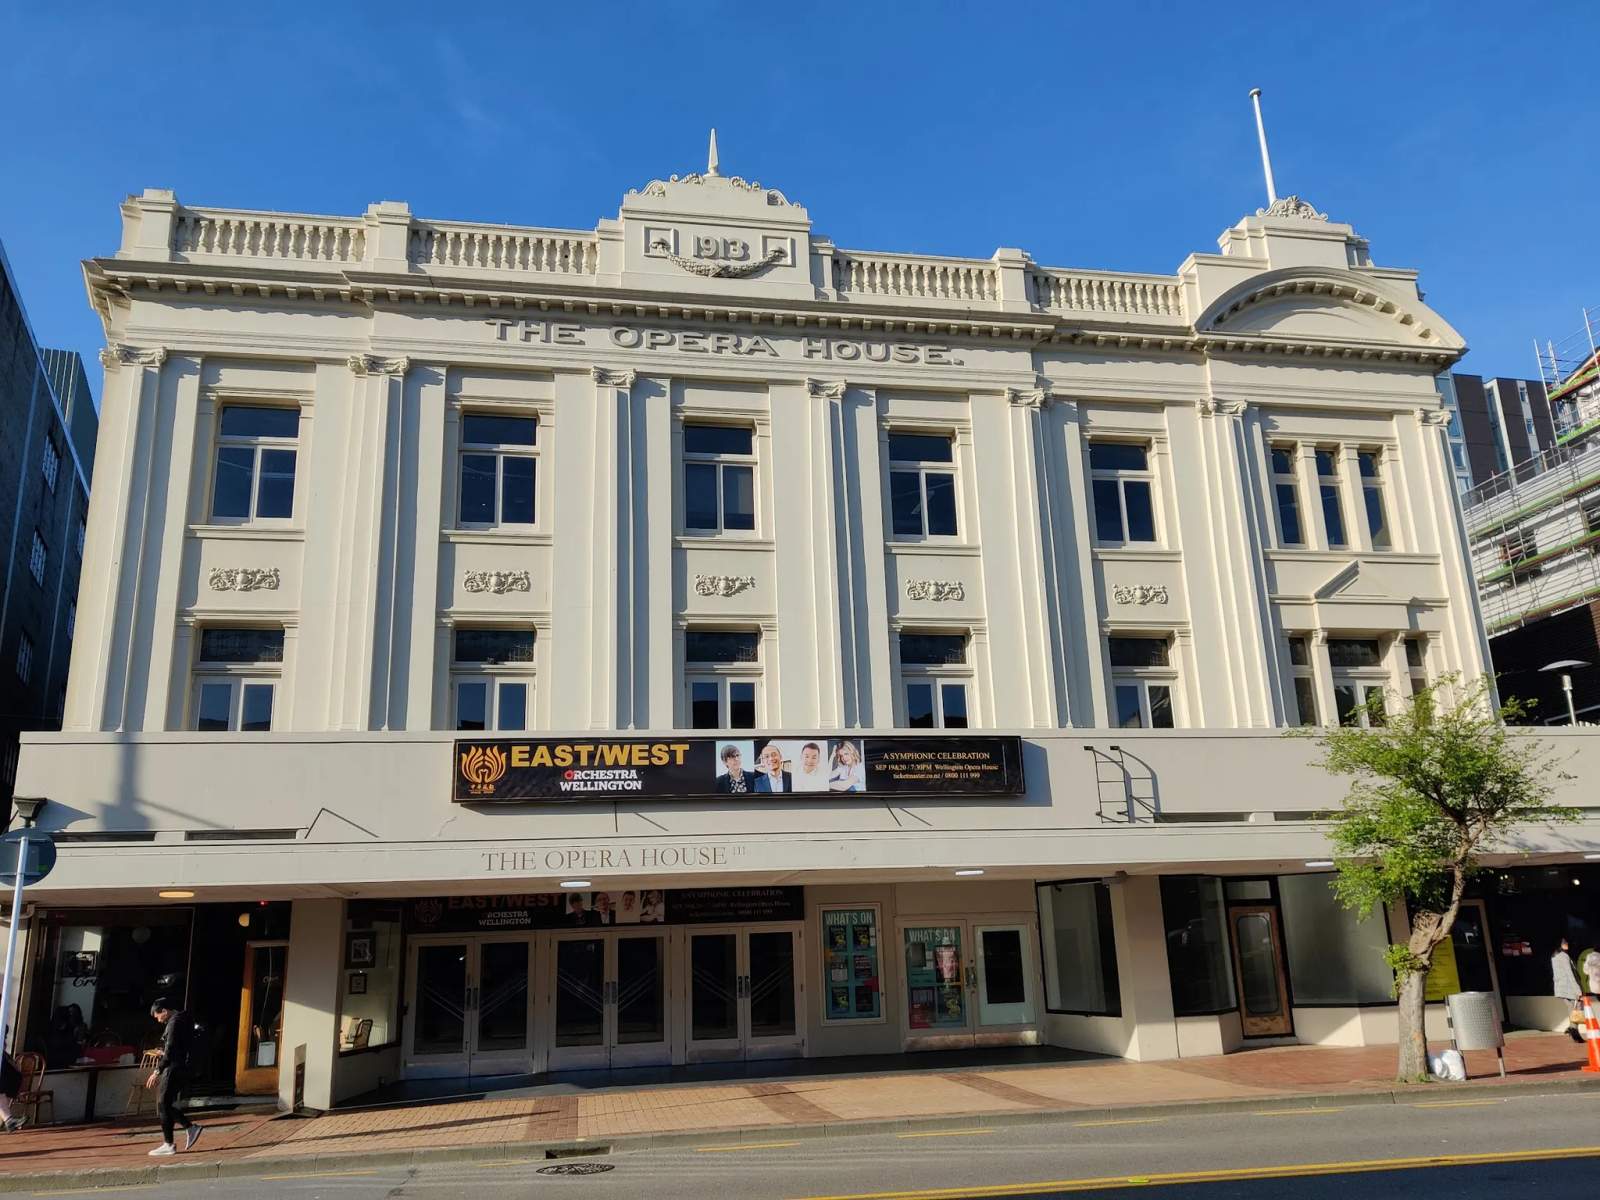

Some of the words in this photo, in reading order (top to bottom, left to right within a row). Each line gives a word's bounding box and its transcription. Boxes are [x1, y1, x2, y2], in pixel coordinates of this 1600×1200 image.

[692, 234, 749, 260] 1913
[485, 318, 585, 346] THE
[608, 326, 780, 357] OPERA
[511, 744, 690, 767] EAST/WEST
[883, 752, 889, 760] A
[890, 752, 936, 760] SYMPHONIC
[937, 752, 990, 760] CELEBRATION
[564, 769, 638, 780] ORCHESTRA
[560, 780, 642, 792] WELLINGTON
[481, 851, 537, 872] THE
[544, 848, 632, 871] OPERA
[641, 846, 727, 867] HOUSE
[449, 894, 562, 909] EAST/WEST
[481, 910, 529, 919] RCHESTRA
[825, 912, 858, 925] WHAT'S
[860, 911, 873, 924] ON
[478, 918, 531, 926] WELLINGTON
[908, 929, 941, 943] WHAT'S
